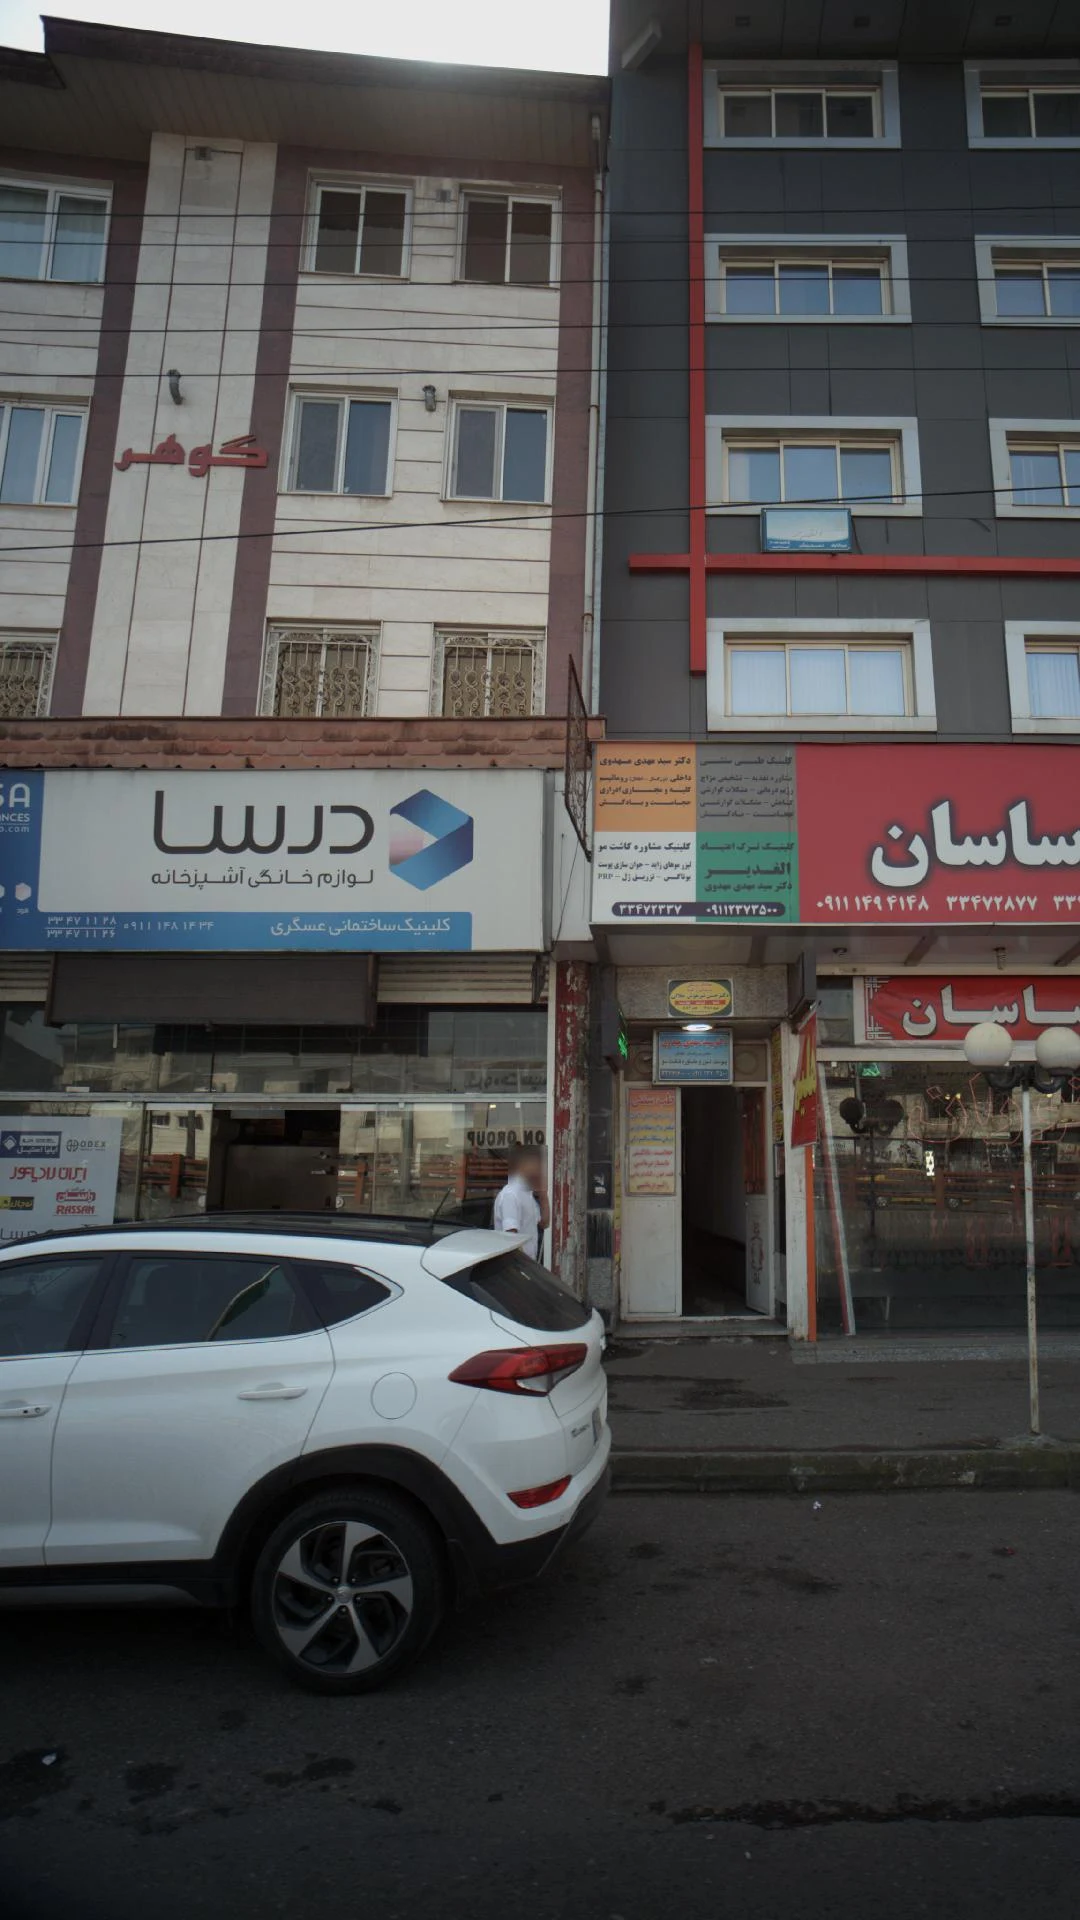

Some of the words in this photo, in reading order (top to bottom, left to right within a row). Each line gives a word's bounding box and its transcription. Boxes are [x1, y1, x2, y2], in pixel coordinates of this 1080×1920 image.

[114, 433, 269, 477] گوهر
[600, 757, 631, 766] مهدوی
[634, 758, 655, 766] مهدی
[674, 757, 691, 766] دکتر
[670, 774, 691, 782] داخلی
[0, 783, 31, 808] A
[0, 813, 30, 822] NCES
[153, 790, 374, 854] درسا
[609, 842, 631, 850] کاشت
[634, 842, 662, 852] مشاوره
[664, 842, 691, 851] کلینیک
[151, 866, 246, 890] آشپزخانه
[247, 869, 313, 888] خانگی
[317, 869, 374, 888] لوازم
[704, 862, 791, 879] الغدیر
[733, 884, 755, 892] مهدی
[774, 881, 792, 892] دکتر
[817, 896, 849, 911] ۰۹۱۱
[854, 896, 883, 911] ۱۴۹
[887, 896, 929, 911] ۴۱۴۸
[946, 895, 1038, 911] ۳۳۴۷۲۸۷۷
[1053, 895, 1080, 911] ۳۳
[270, 916, 326, 936] عسگری
[328, 917, 397, 936] ساختمانی
[399, 917, 450, 936] کلینیک
[902, 984, 1080, 1037] اسان
